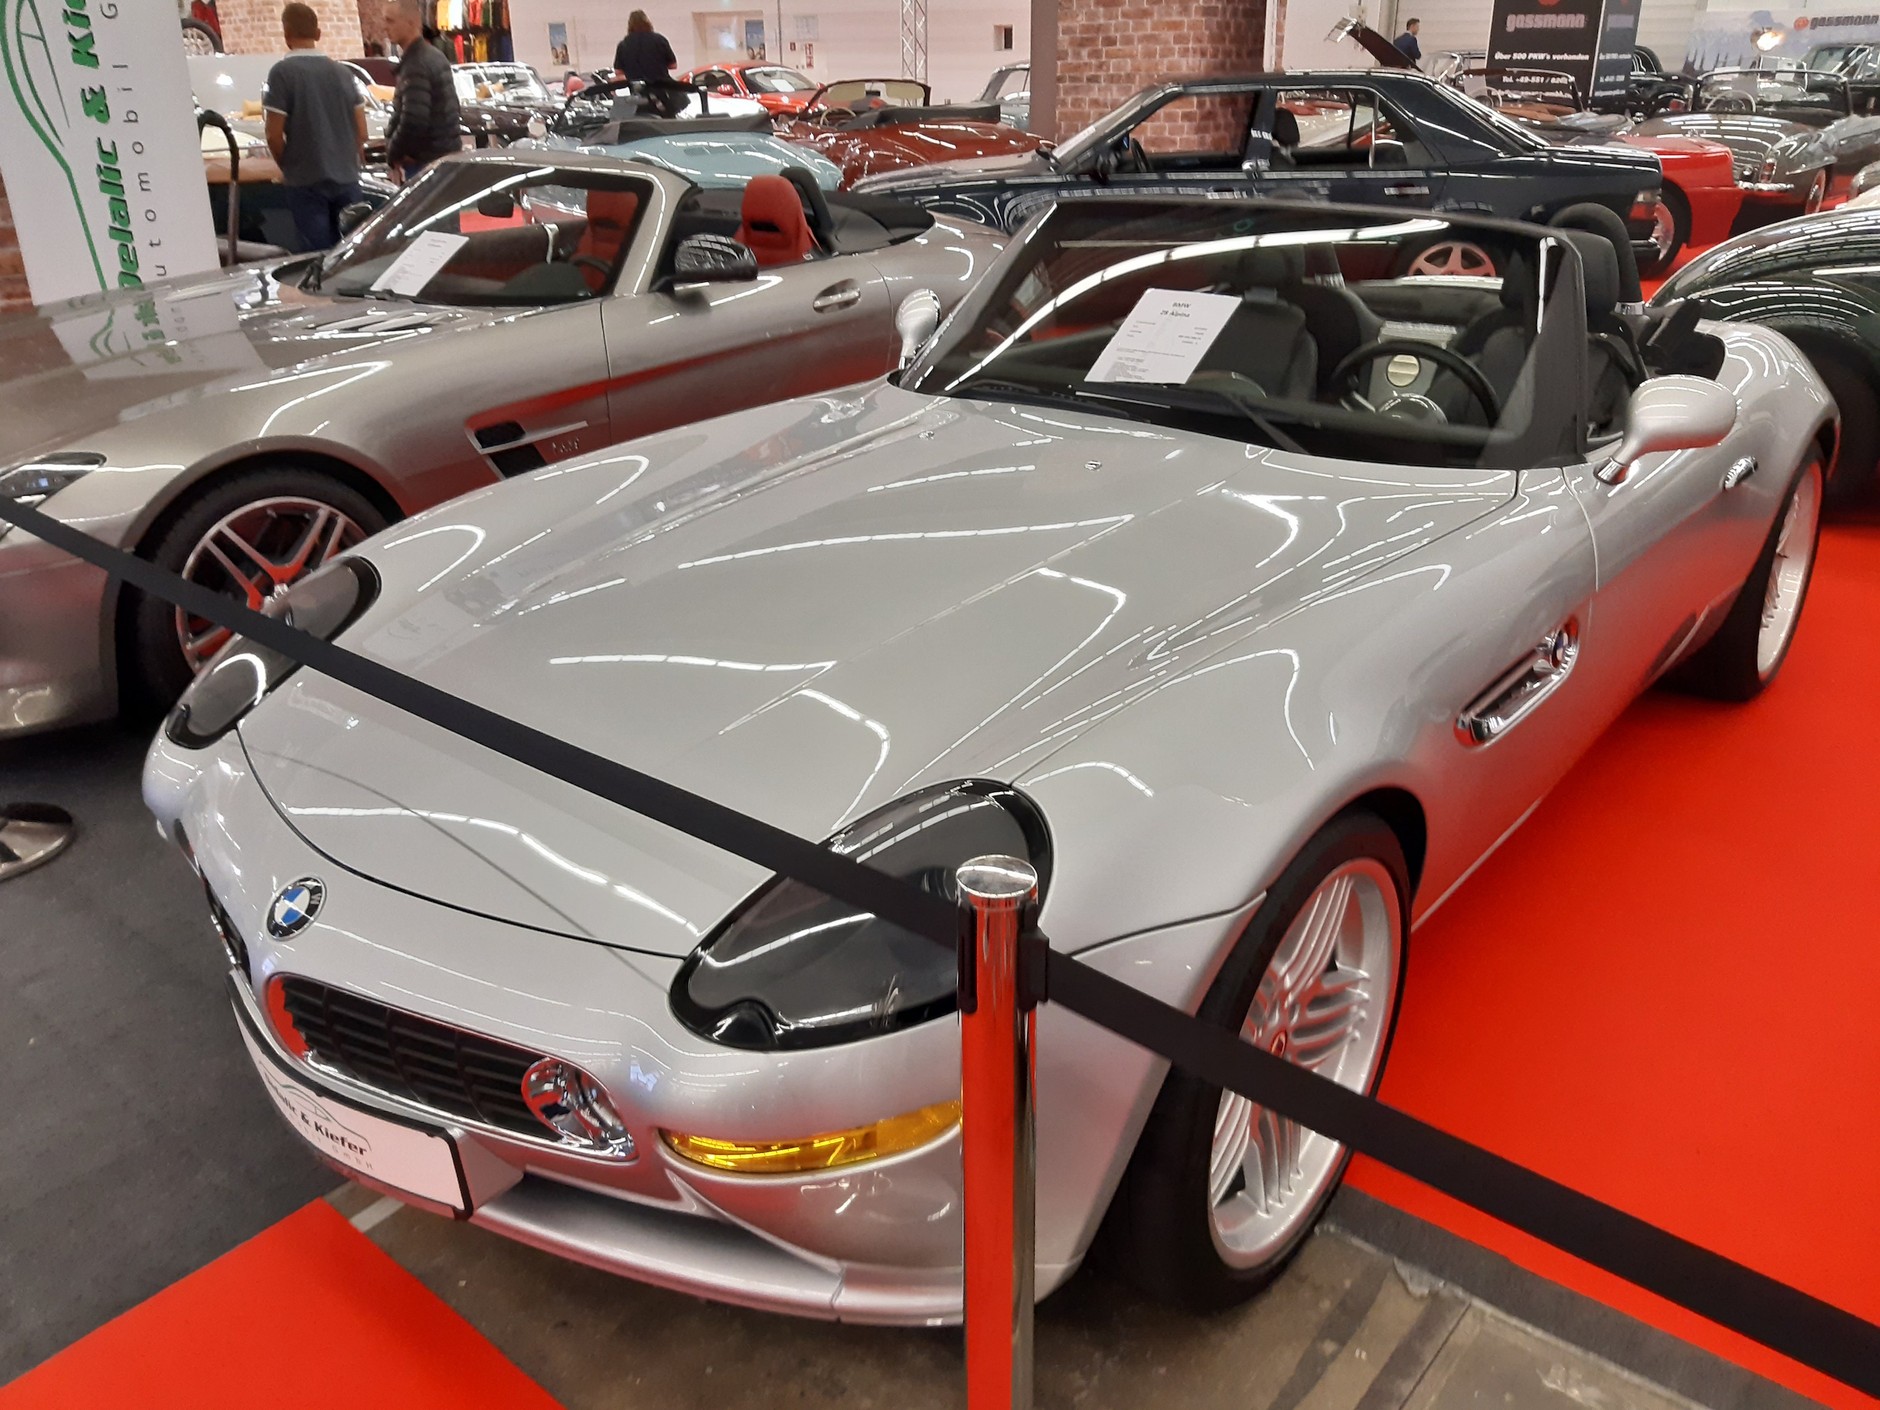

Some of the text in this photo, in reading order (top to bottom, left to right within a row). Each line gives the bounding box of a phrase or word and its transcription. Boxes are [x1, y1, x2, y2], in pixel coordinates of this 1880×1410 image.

[1506, 13, 1585, 32] gassmann
[1810, 14, 1879, 30] gassmann
[1494, 51, 1511, 60] Über
[1512, 52, 1527, 60] 500
[1552, 52, 1590, 61] vorhanden
[80, 84, 110, 124] &
[111, 64, 167, 277] utomobil
[314, 1121, 367, 1156] Kiefer
